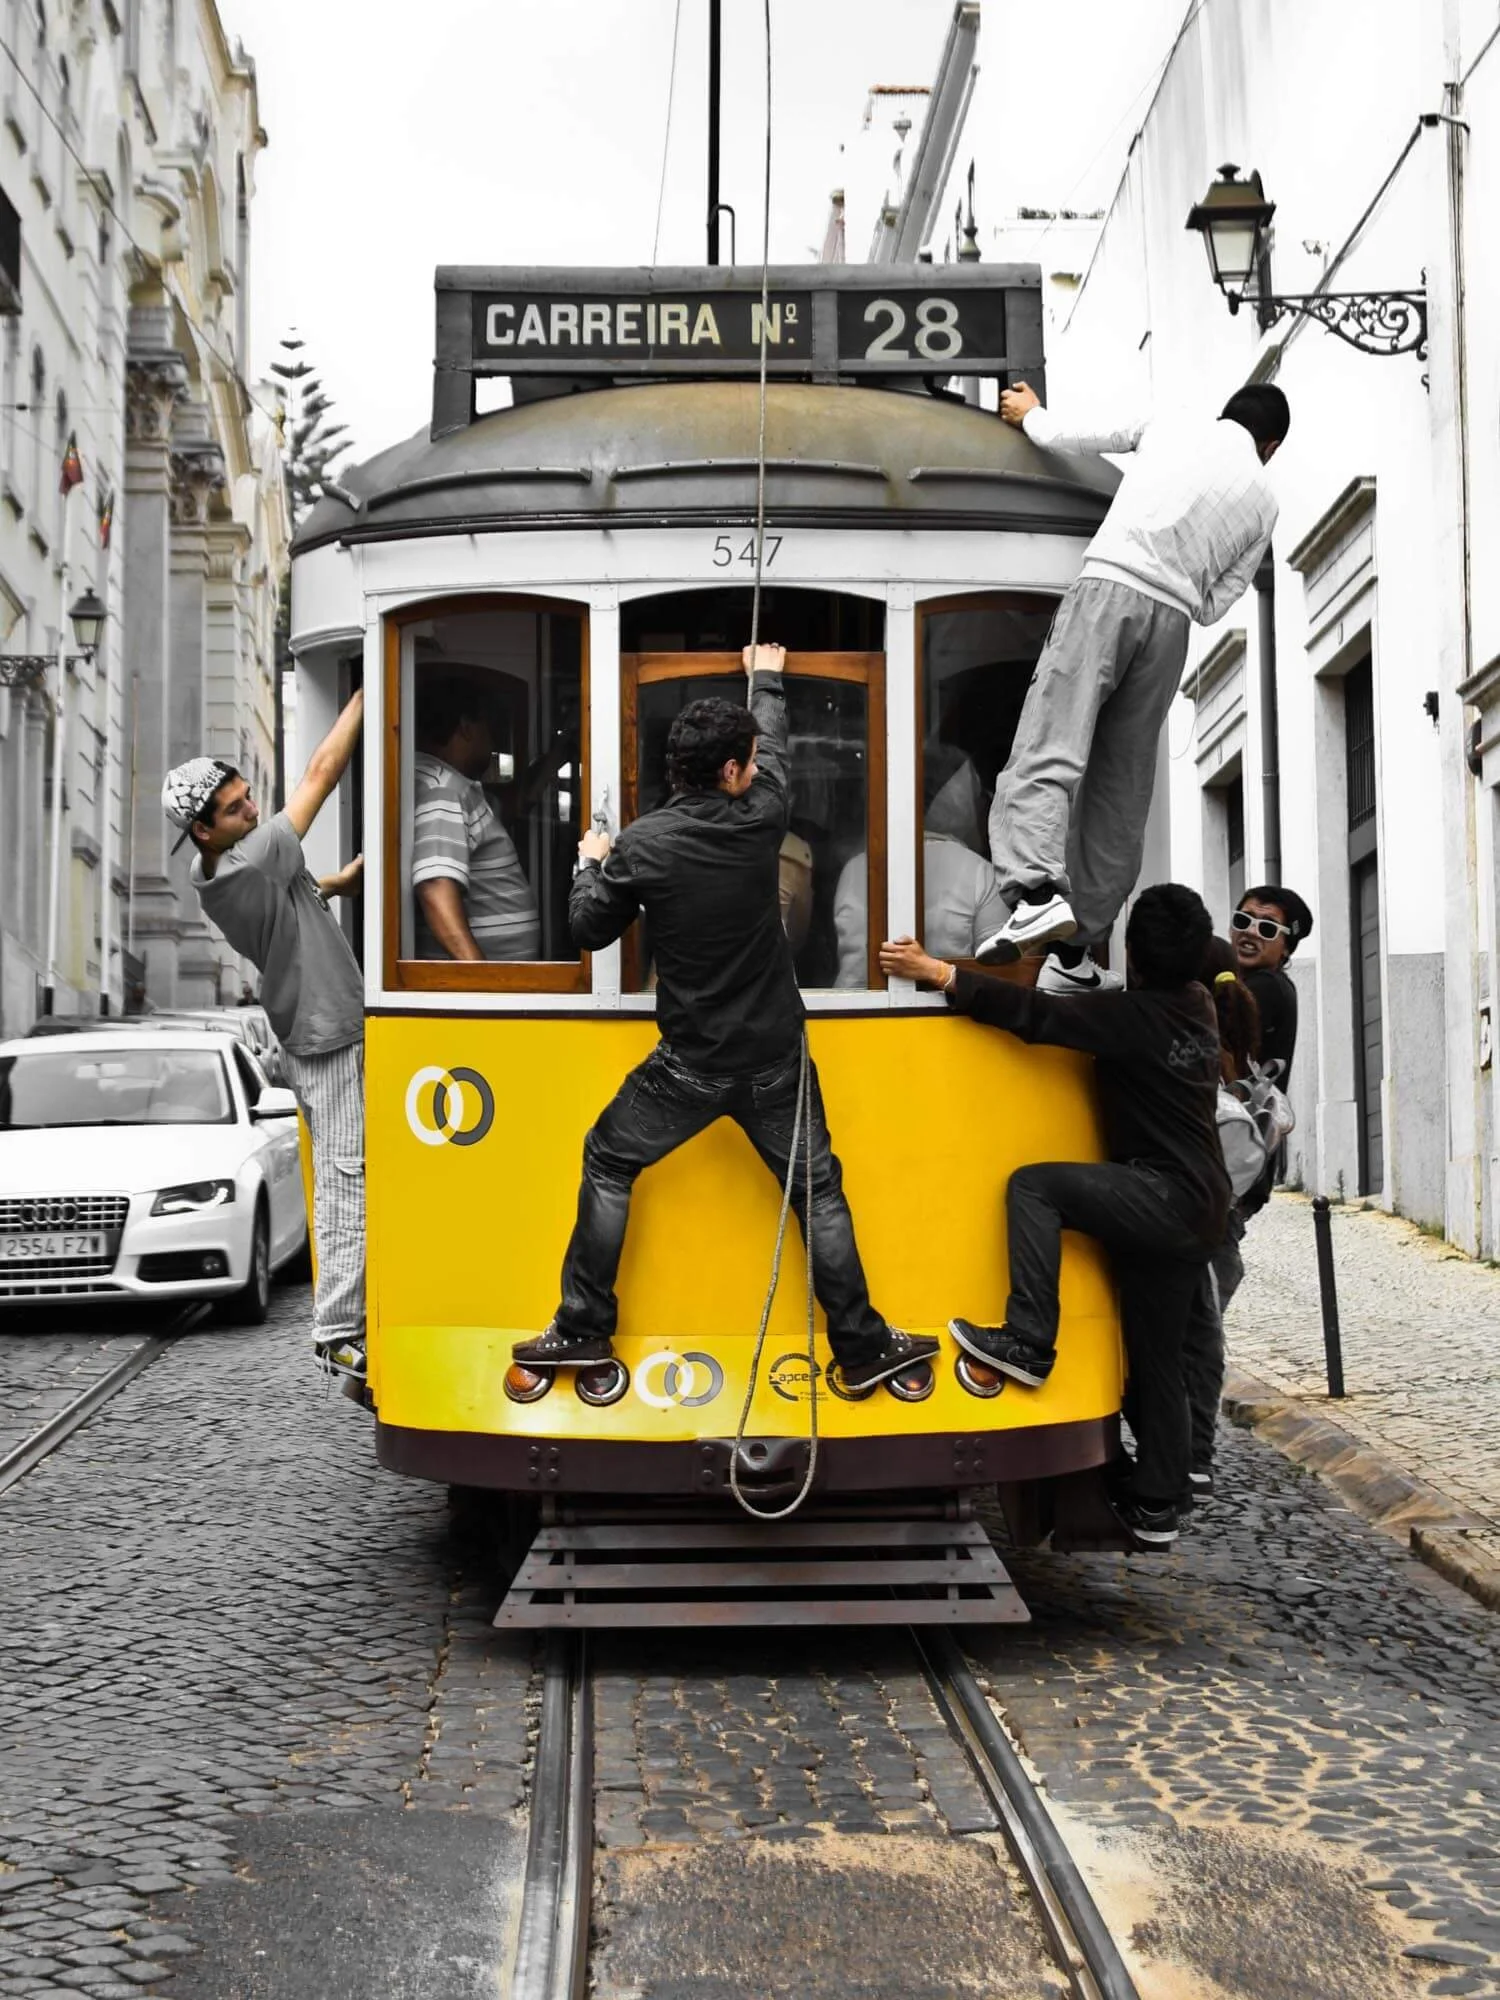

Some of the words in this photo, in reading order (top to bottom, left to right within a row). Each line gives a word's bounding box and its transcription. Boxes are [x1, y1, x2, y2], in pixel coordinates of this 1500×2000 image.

[486, 303, 721, 346] CARREIRA
[864, 297, 963, 361] 28
[712, 535, 783, 568] 547
[6, 1237, 56, 1257] 2554
